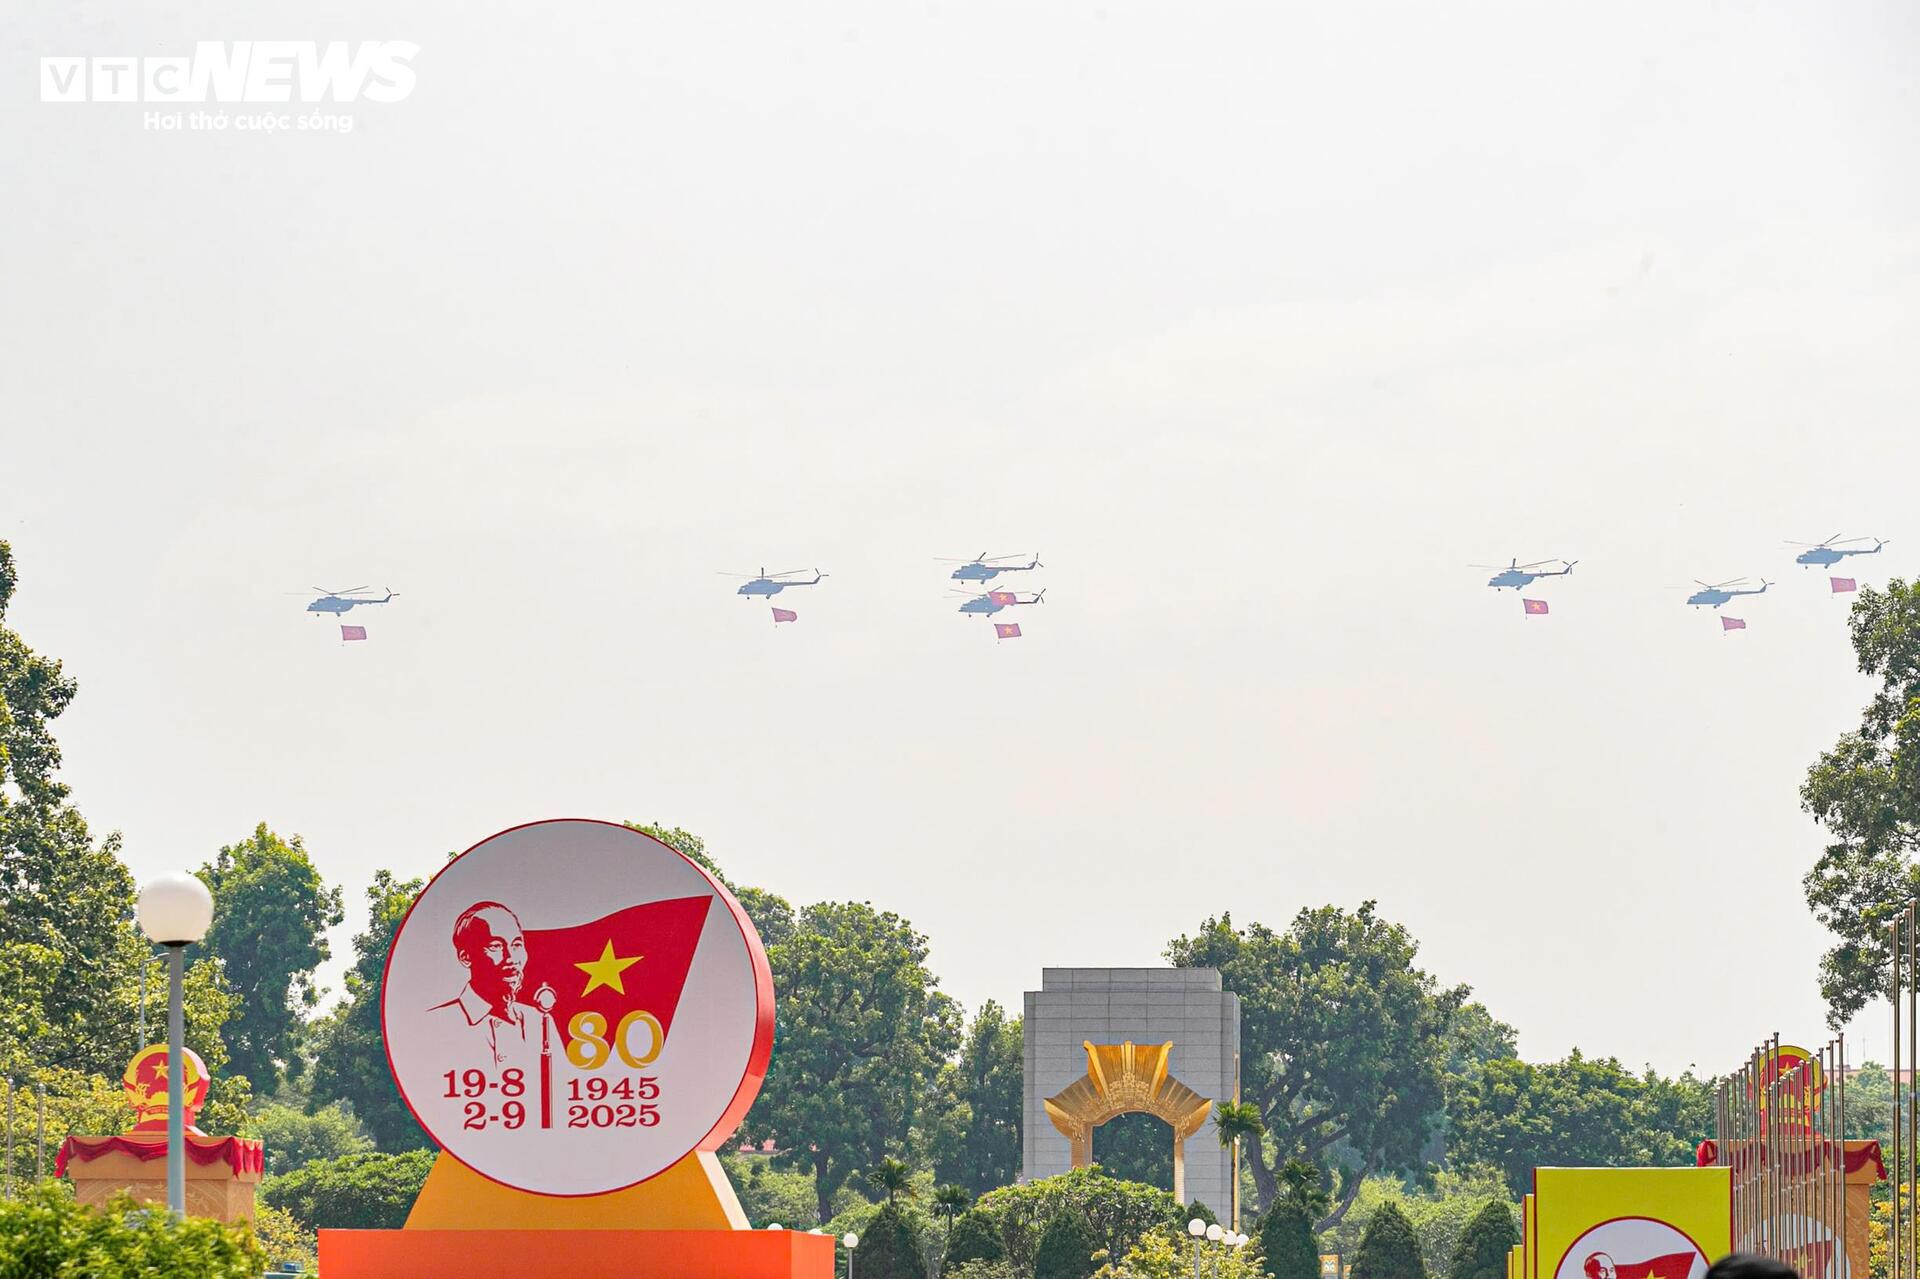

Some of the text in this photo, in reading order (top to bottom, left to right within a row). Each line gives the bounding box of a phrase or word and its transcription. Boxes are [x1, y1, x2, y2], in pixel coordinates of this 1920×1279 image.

[566, 1009, 665, 1070] 80
[443, 1068, 526, 1098] 19-8
[567, 1077, 660, 1101] 1945
[463, 1101, 526, 1130] 2-9
[568, 1104, 661, 1128] 2025
